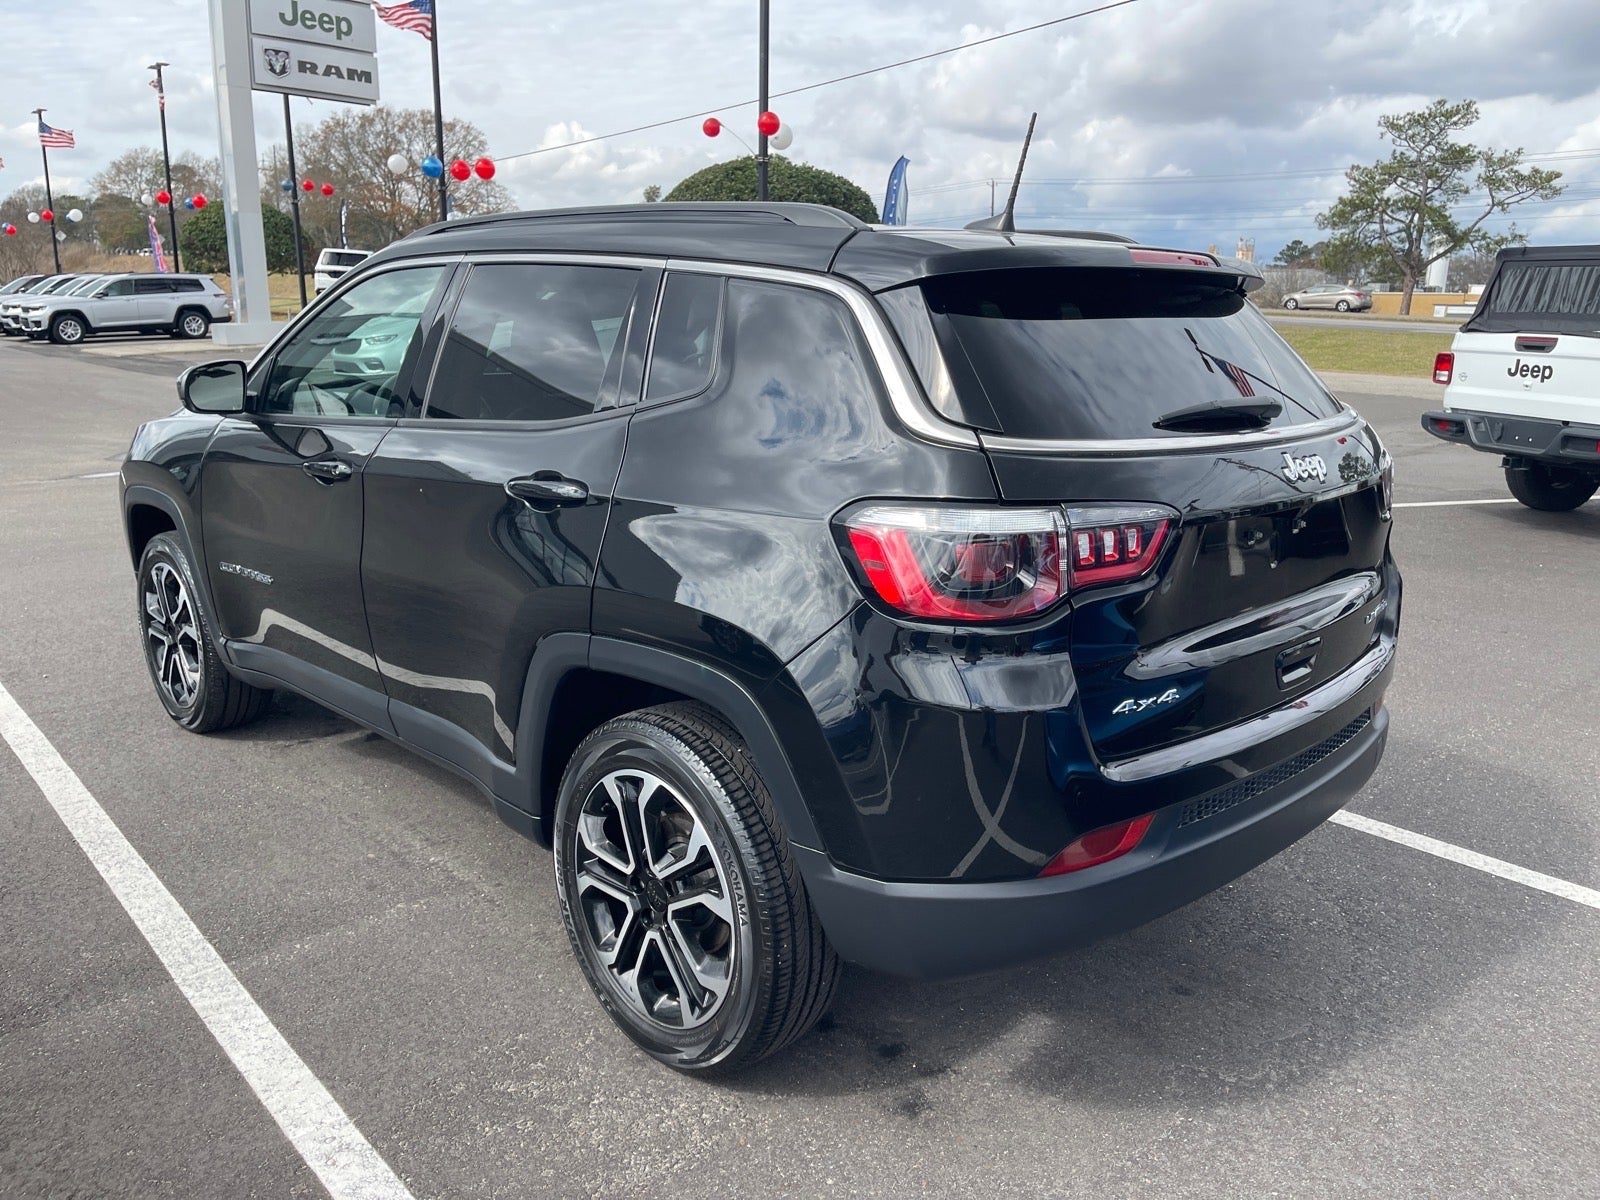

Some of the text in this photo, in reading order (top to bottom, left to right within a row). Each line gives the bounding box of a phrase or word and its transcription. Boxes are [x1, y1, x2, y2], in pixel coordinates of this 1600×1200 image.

[278, 0, 353, 40] Jeep
[297, 60, 372, 84] RAM
[1507, 359, 1553, 383] Jeep
[1281, 452, 1328, 484] Jeep
[720, 841, 750, 927] YOKOHAMA
